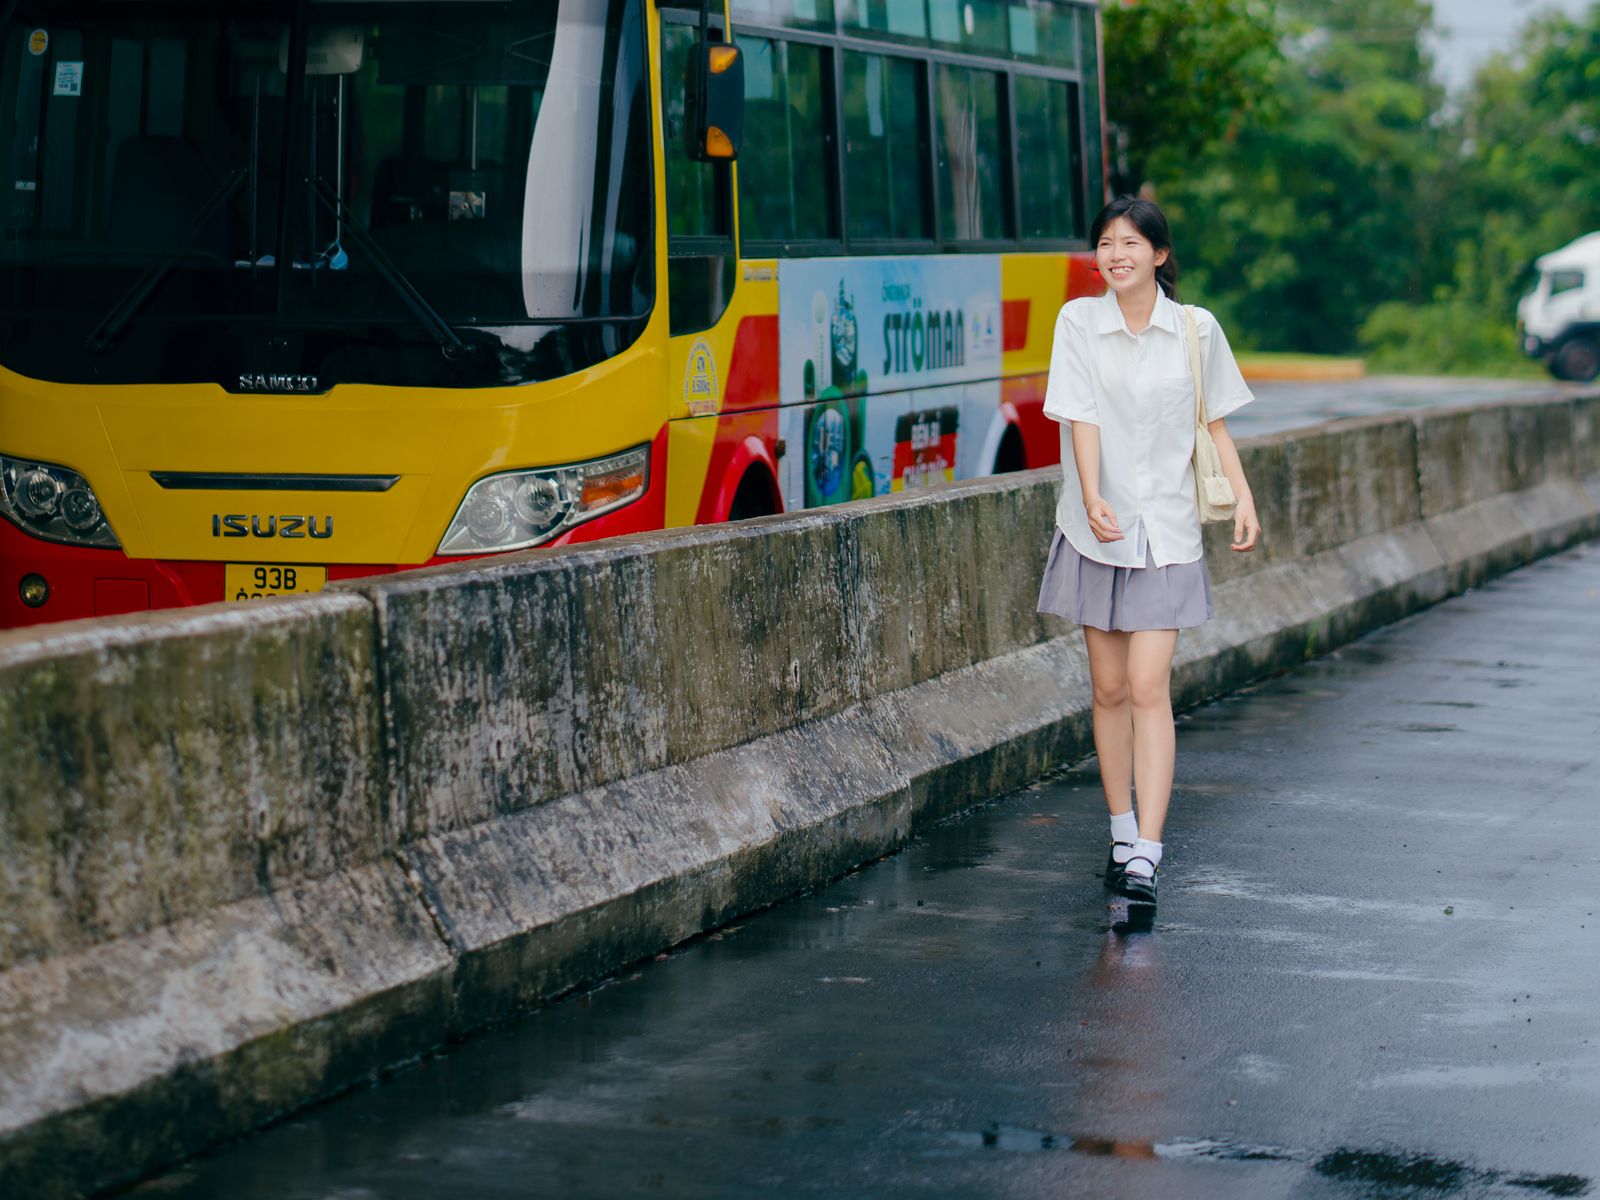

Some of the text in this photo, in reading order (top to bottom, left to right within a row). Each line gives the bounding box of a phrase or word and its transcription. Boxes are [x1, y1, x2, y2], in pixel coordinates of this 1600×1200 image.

[239, 373, 318, 390] SAMCO
[212, 514, 333, 538] ISUZU
[254, 567, 297, 590] 93B
